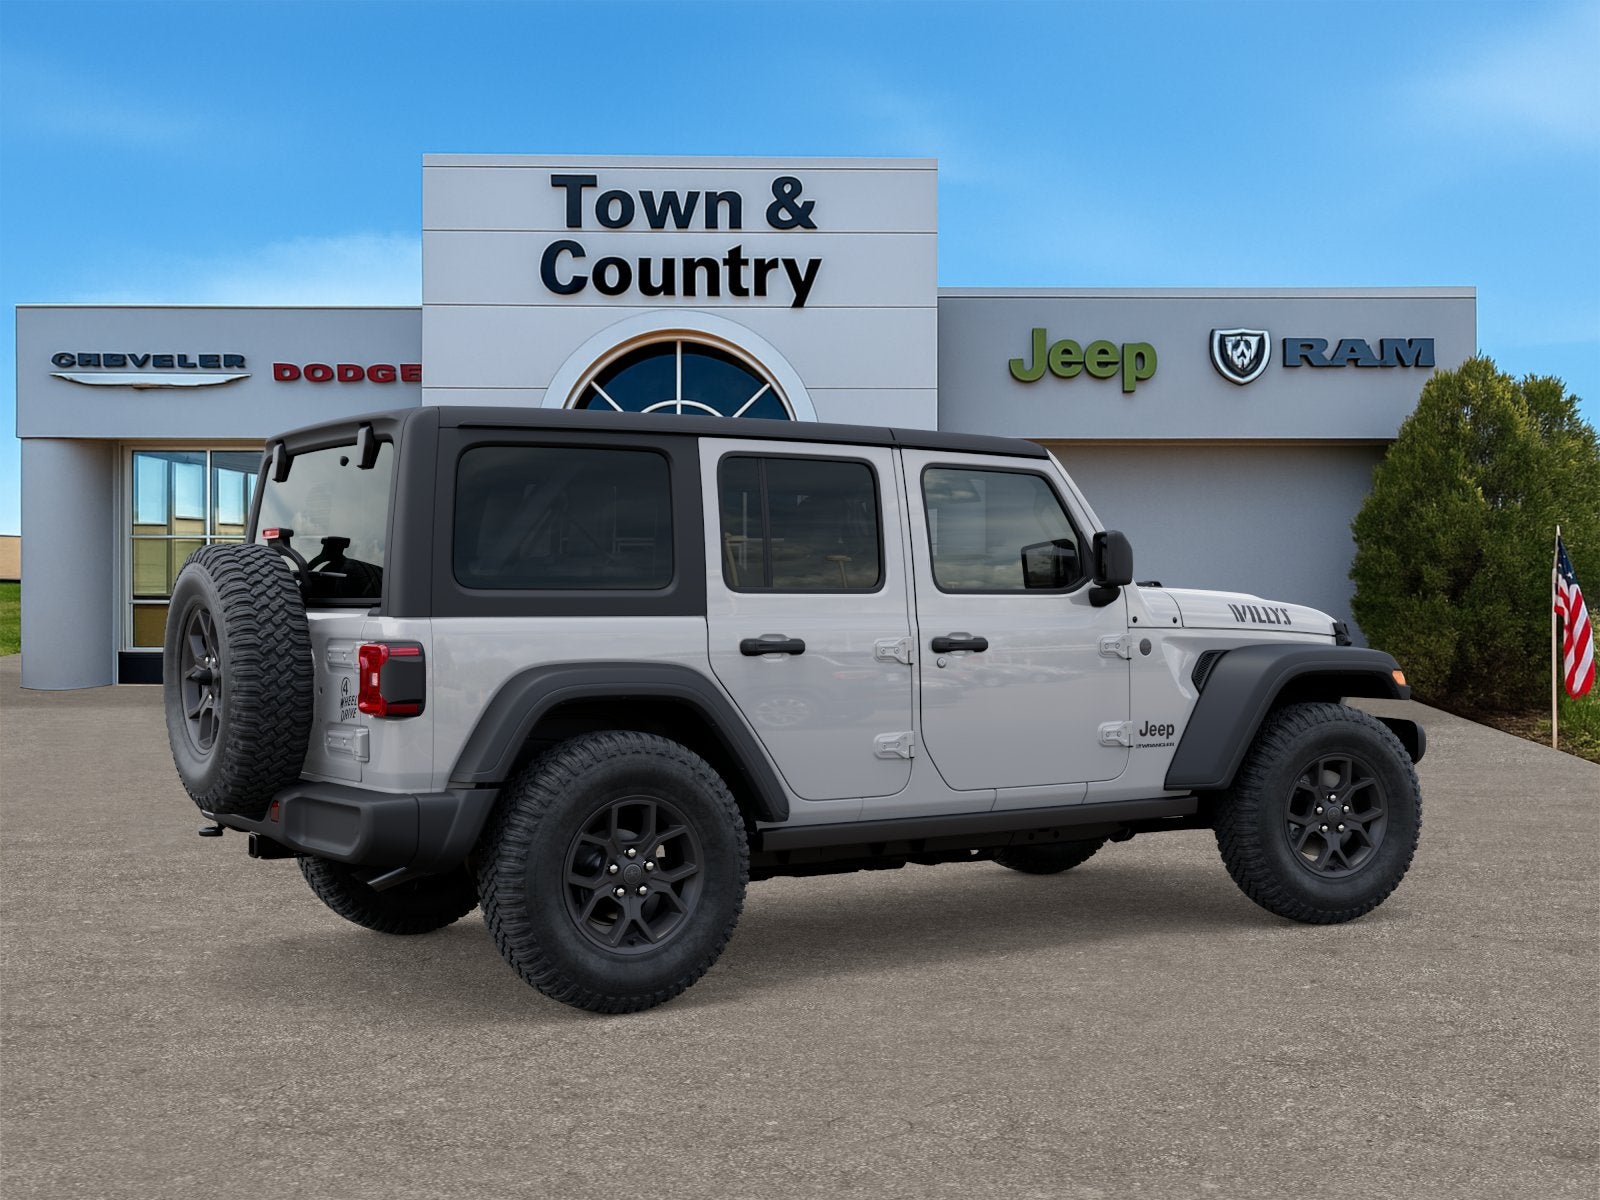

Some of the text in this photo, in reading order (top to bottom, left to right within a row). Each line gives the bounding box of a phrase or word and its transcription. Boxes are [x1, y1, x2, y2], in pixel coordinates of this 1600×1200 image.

[551, 174, 818, 229] Town &
[540, 239, 822, 308] Country
[1009, 328, 1158, 393] Jeep
[1283, 337, 1435, 367] RAM
[273, 363, 421, 383] DODGE
[1228, 603, 1292, 626] WILLYS
[341, 708, 357, 722] DRIVE
[1139, 720, 1175, 739] Jeep
